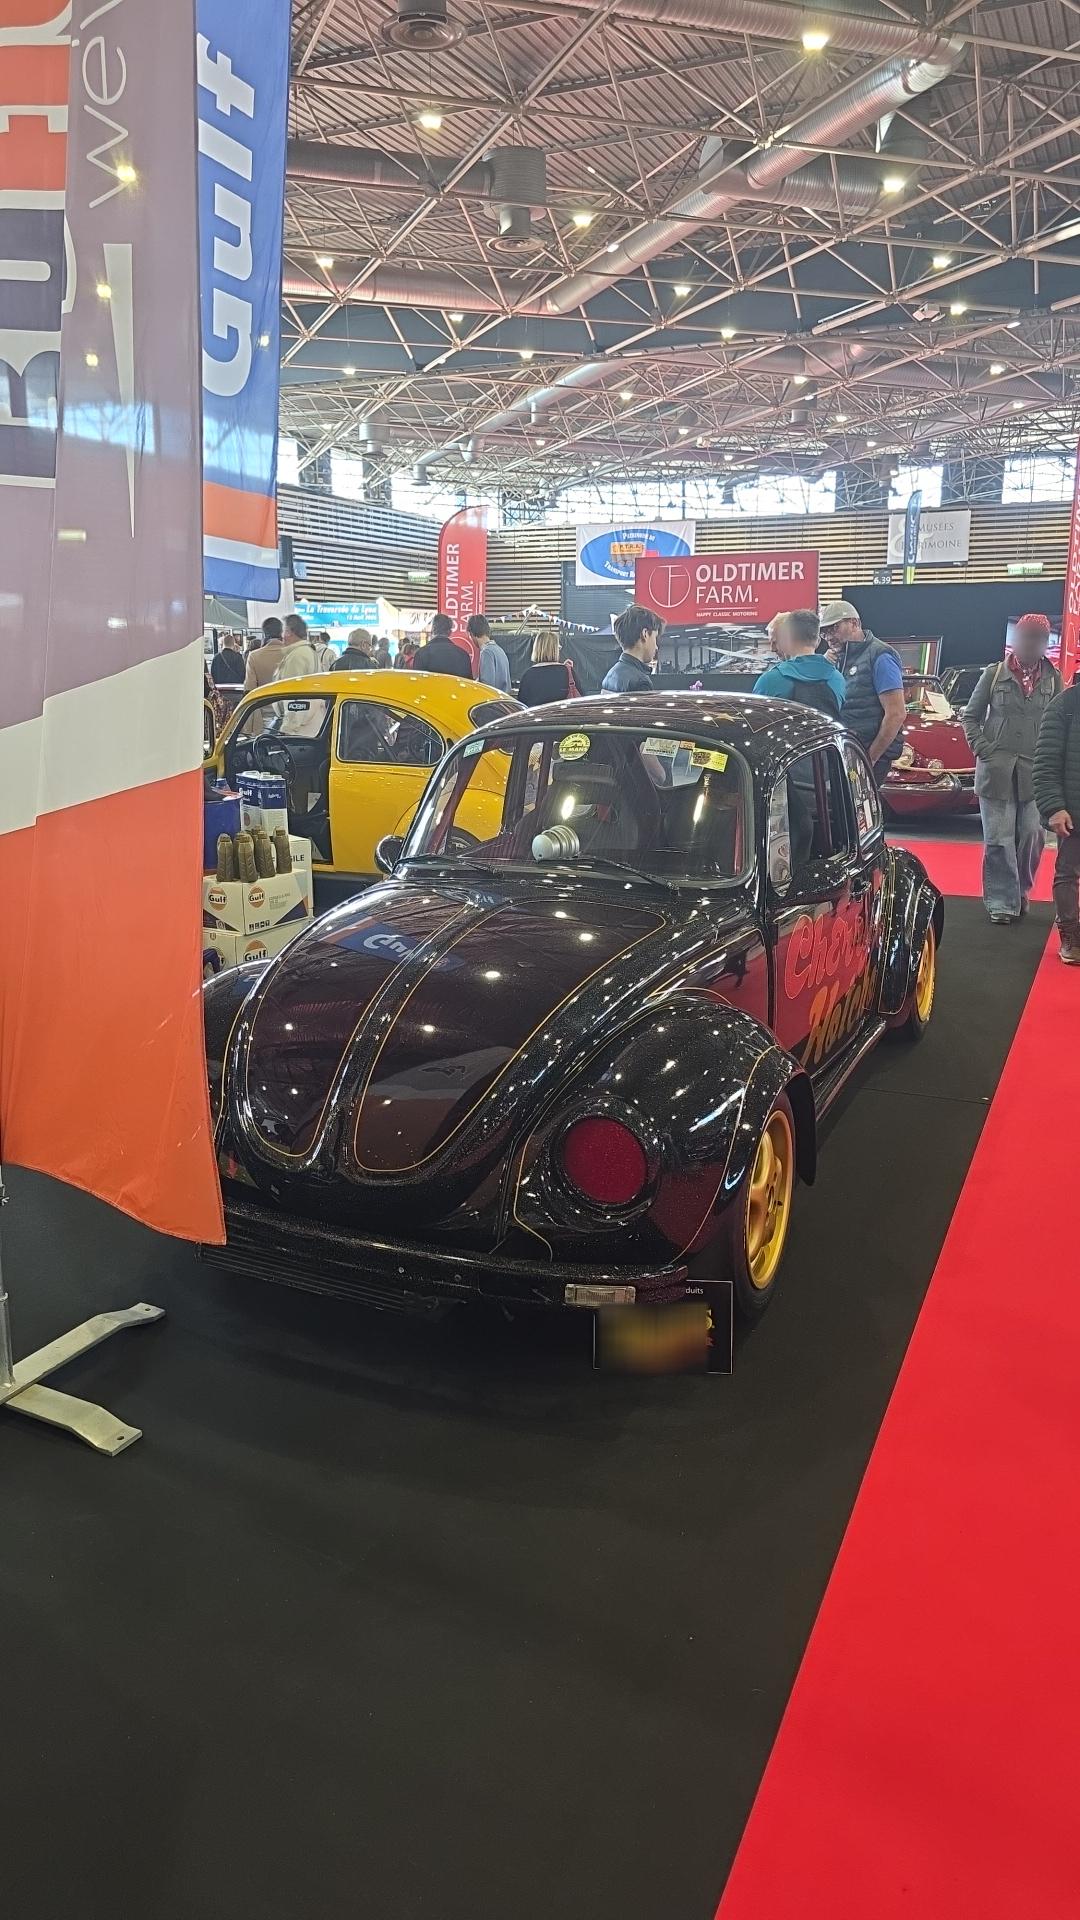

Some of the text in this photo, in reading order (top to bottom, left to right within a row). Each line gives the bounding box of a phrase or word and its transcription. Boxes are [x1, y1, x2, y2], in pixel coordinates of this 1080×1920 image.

[196, 32, 255, 397] Gulf
[695, 561, 805, 583] OLDTIMER
[873, 576, 891, 584] 6.39
[696, 585, 759, 604] FARM.
[208, 894, 227, 904] Gulf
[249, 893, 265, 902] Gulf
[244, 949, 267, 962] Gulf
[685, 1286, 704, 1295] duits
